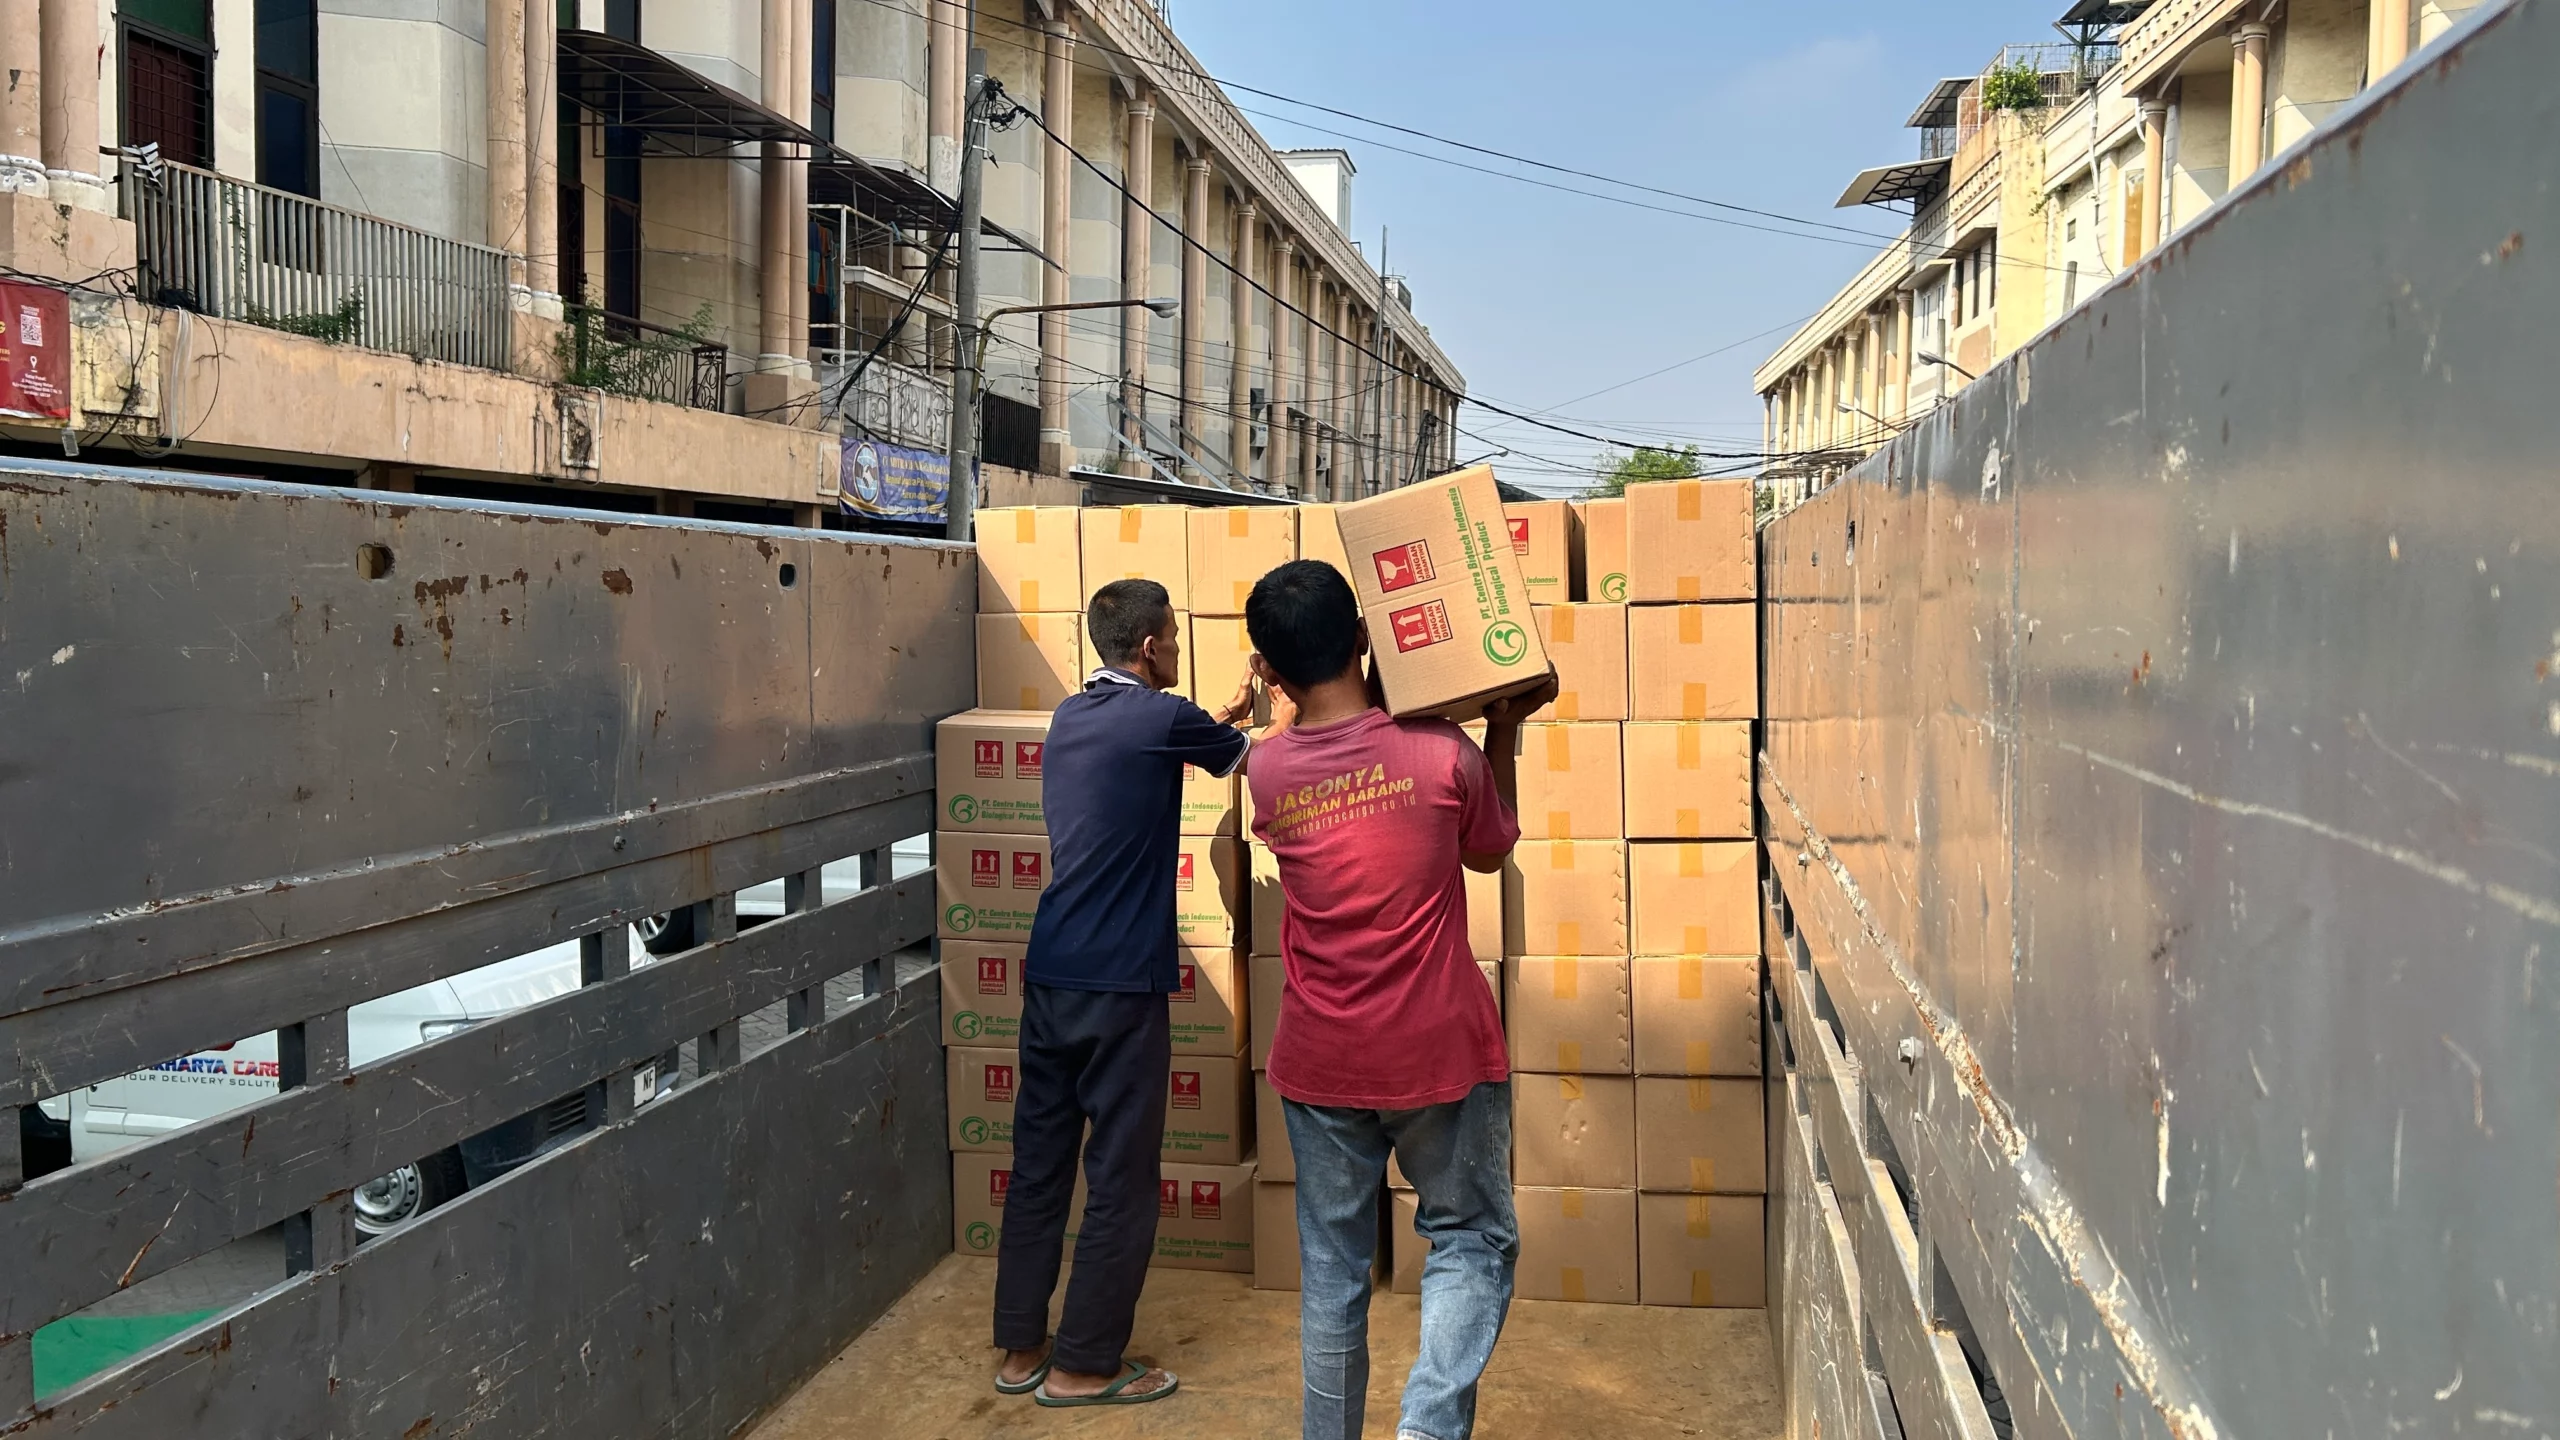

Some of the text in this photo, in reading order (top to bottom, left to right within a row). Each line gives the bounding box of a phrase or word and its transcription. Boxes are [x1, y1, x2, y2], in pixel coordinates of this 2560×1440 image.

[1410, 545, 1425, 580] JANGAN
[1417, 544, 1431, 579] DIBANTING
[1447, 487, 1492, 620] PT. Centra Biotech Indonesia
[1475, 521, 1510, 615] Biological Product
[1526, 576, 1558, 584] Indonesia
[1417, 622, 1424, 632] UP
[1427, 605, 1441, 640] JANGAN
[1434, 604, 1449, 638] DIBALIK
[1267, 777, 1415, 834] NGIRIMAN BARANG
[1274, 763, 1385, 816] JAGONYA
[982, 811, 1014, 821] Biological
[978, 921, 1032, 930] Biological Prod
[150, 1057, 279, 1077] KHARYA CARG
[162, 1075, 224, 1085] DELIVERY
[229, 1078, 279, 1088] SOLUTI
[992, 1133, 1013, 1142] Biolog
